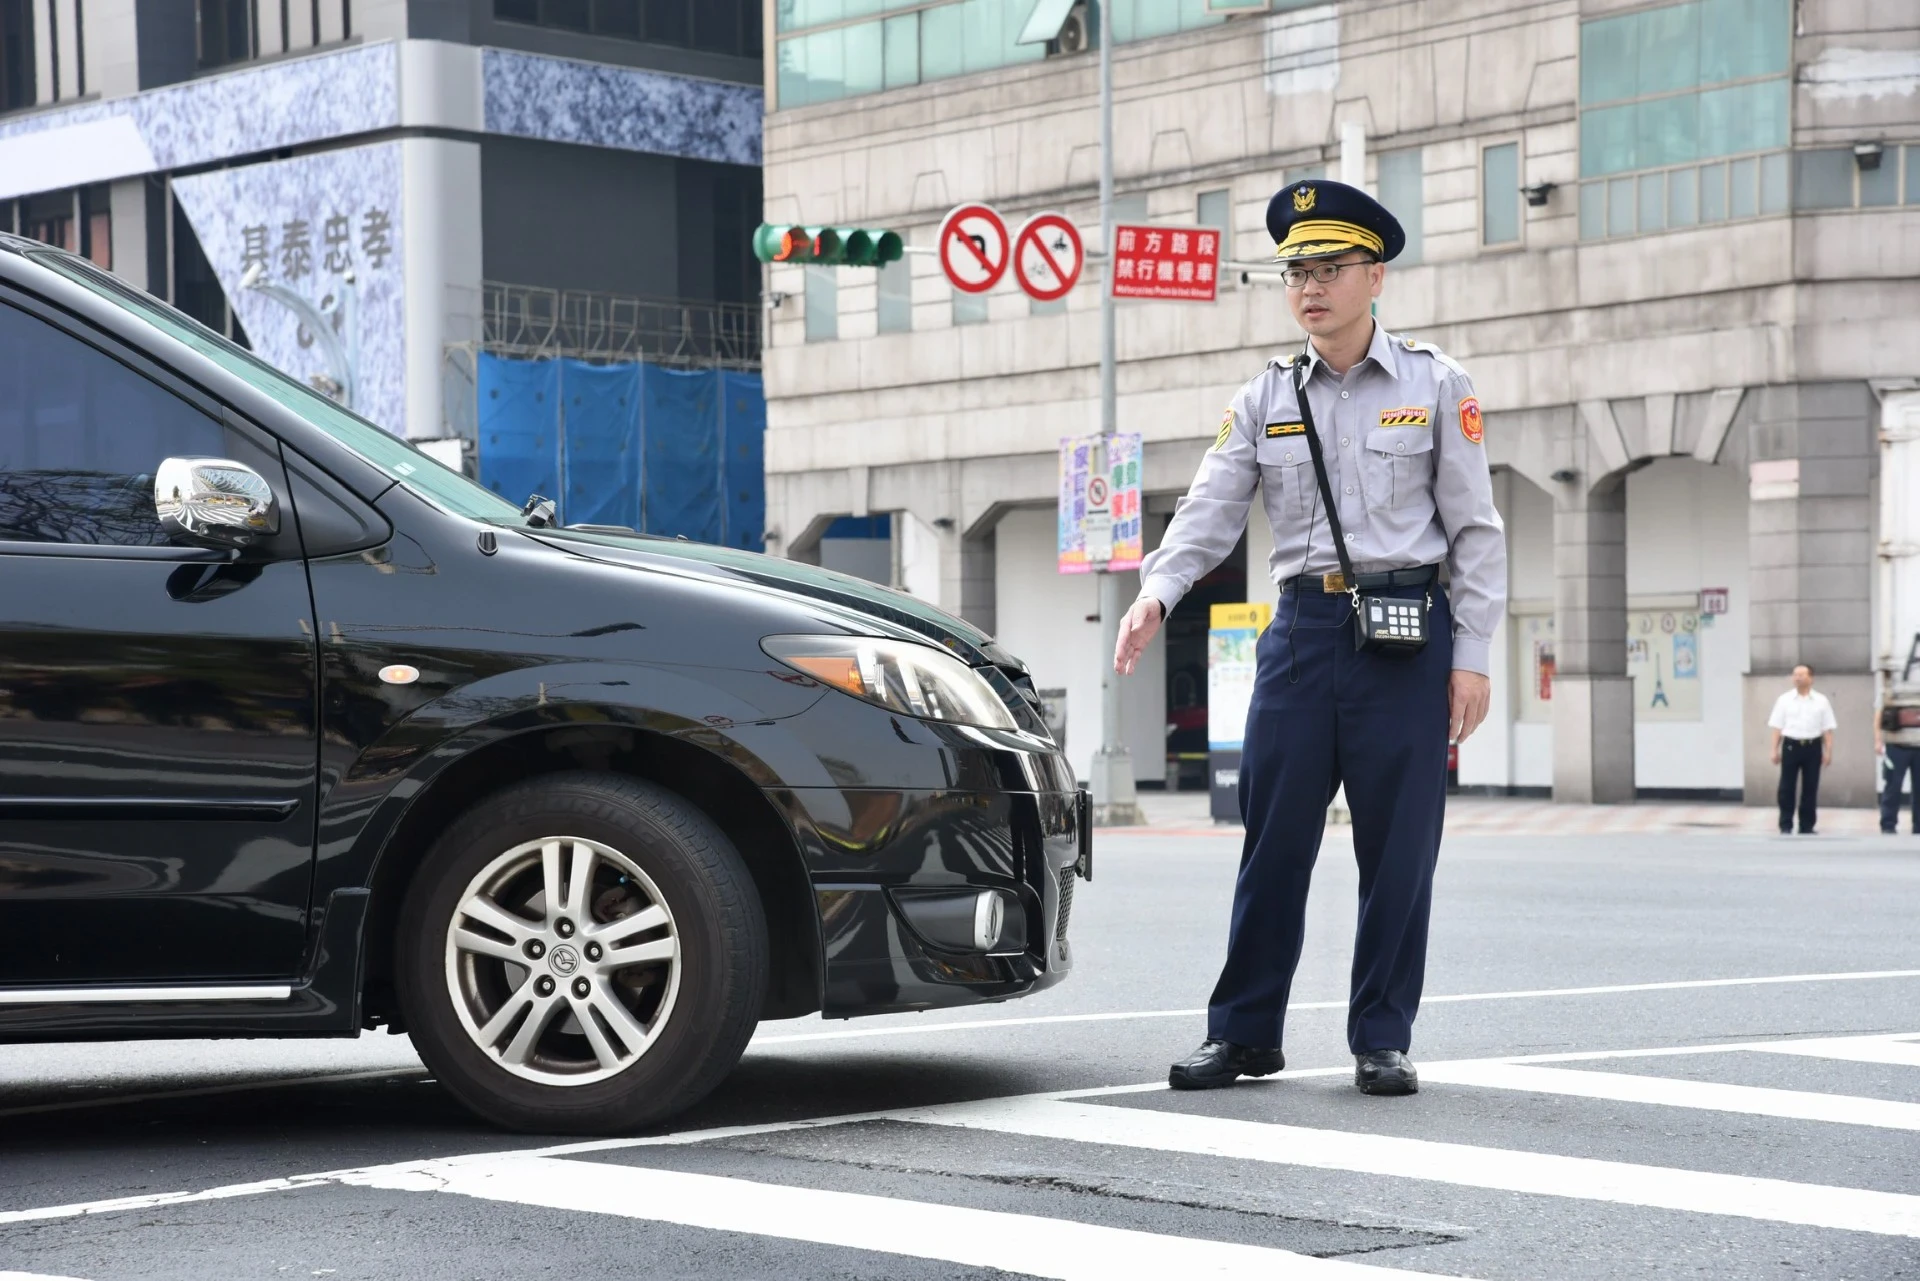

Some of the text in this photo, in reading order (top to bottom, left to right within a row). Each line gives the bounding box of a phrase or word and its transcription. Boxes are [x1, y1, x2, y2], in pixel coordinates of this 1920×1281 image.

[1118, 229, 1214, 256] 前方路段
[1117, 258, 1213, 283] 禁行機慢車
